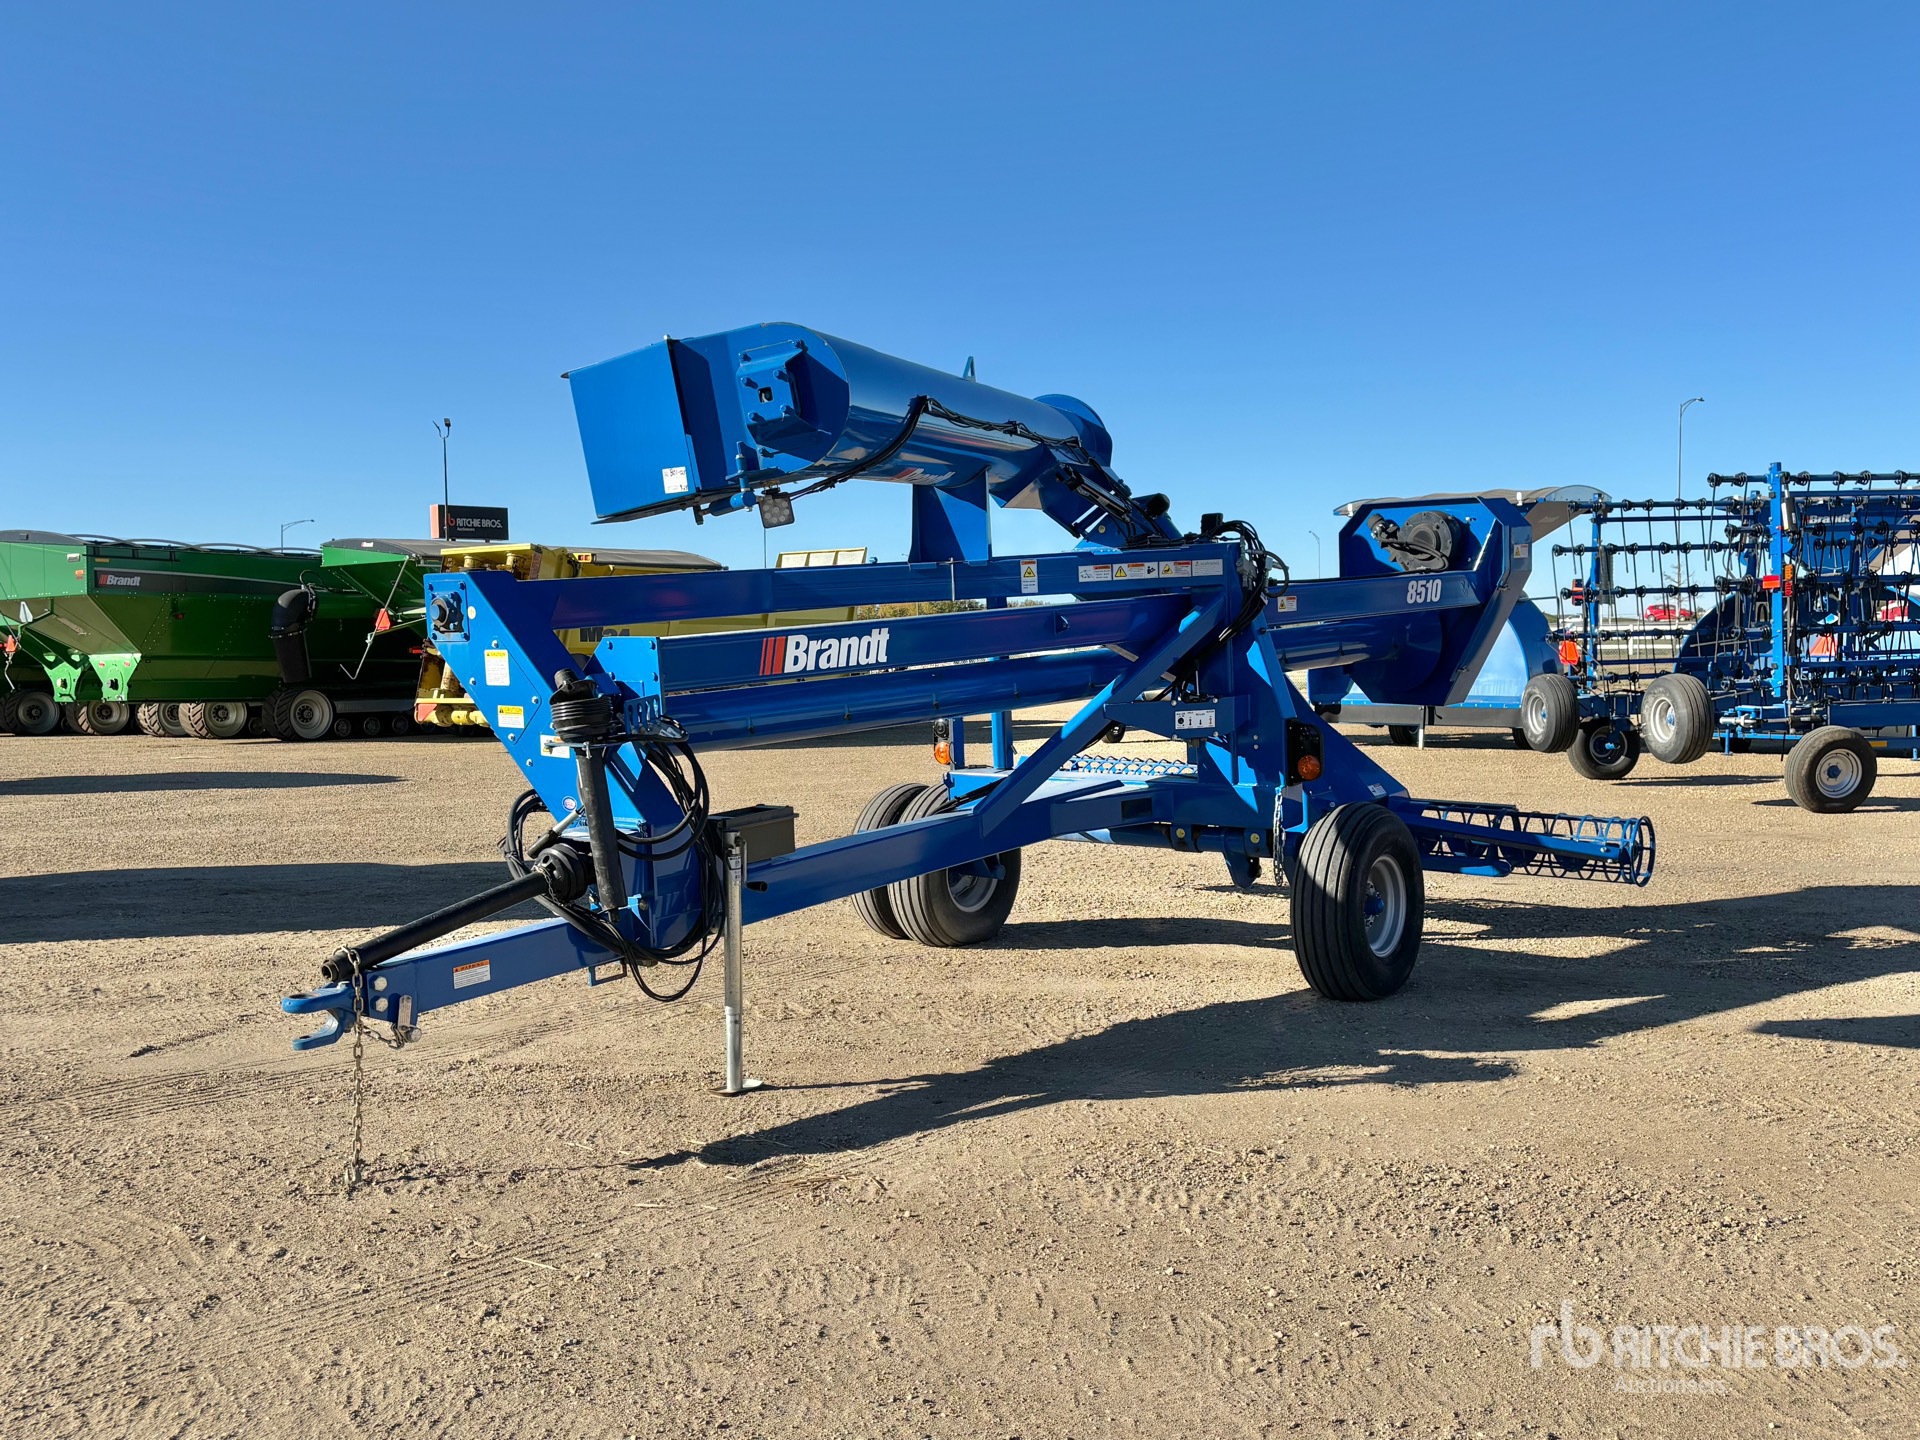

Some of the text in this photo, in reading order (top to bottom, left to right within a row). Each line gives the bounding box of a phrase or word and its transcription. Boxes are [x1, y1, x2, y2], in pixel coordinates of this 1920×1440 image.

[456, 518, 481, 528] RITCHIE
[481, 519, 504, 528] BROS.
[107, 574, 141, 586] Brandt
[1406, 578, 1442, 604] 8510
[783, 627, 890, 674] Brandt
